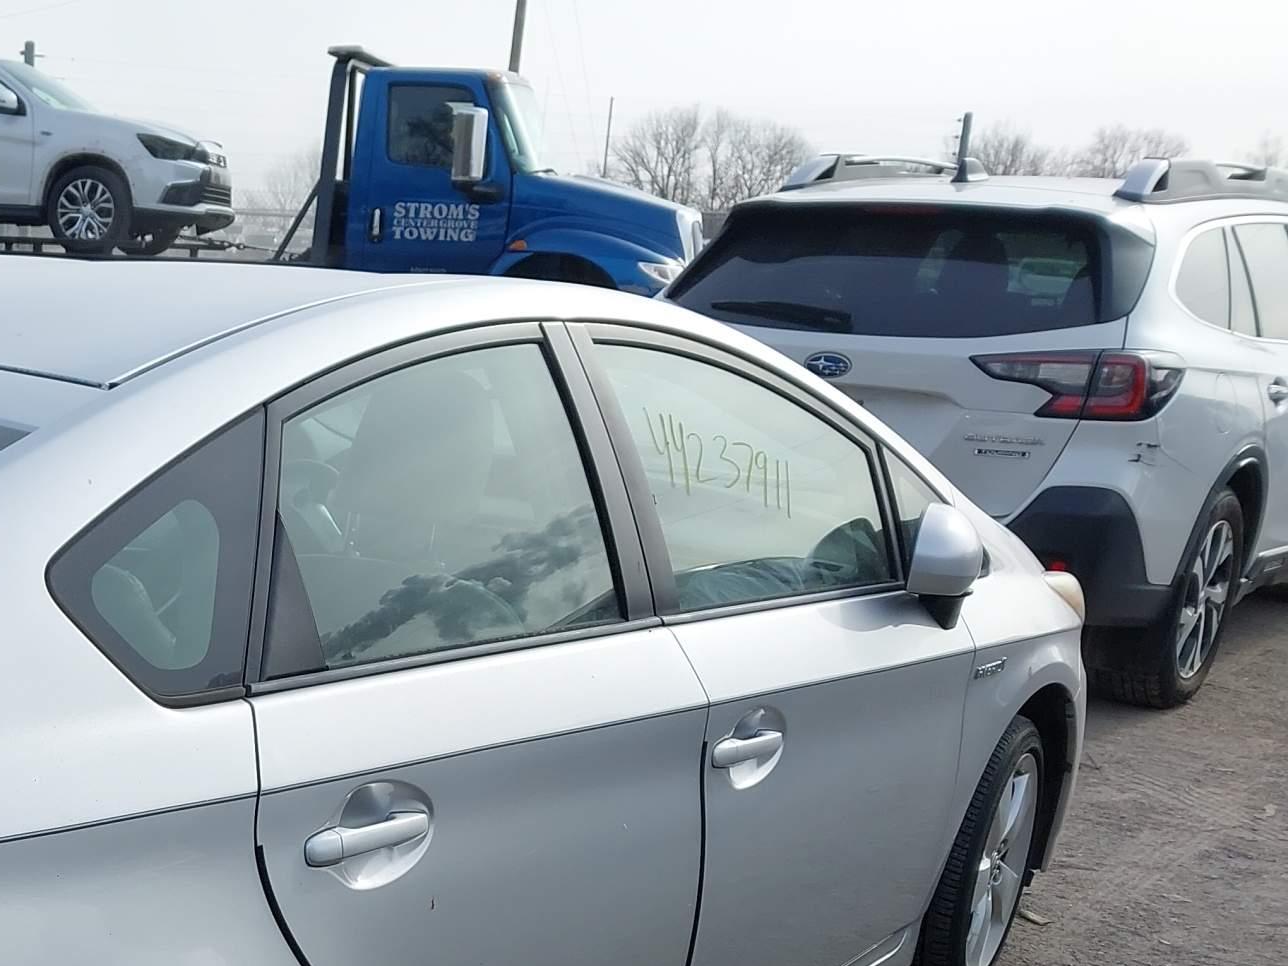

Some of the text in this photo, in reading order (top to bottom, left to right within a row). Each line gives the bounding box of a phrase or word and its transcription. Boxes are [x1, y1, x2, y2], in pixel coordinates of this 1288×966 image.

[393, 202, 480, 219] STROM'S
[392, 226, 477, 242] TOWING
[643, 407, 791, 519] 44237911
